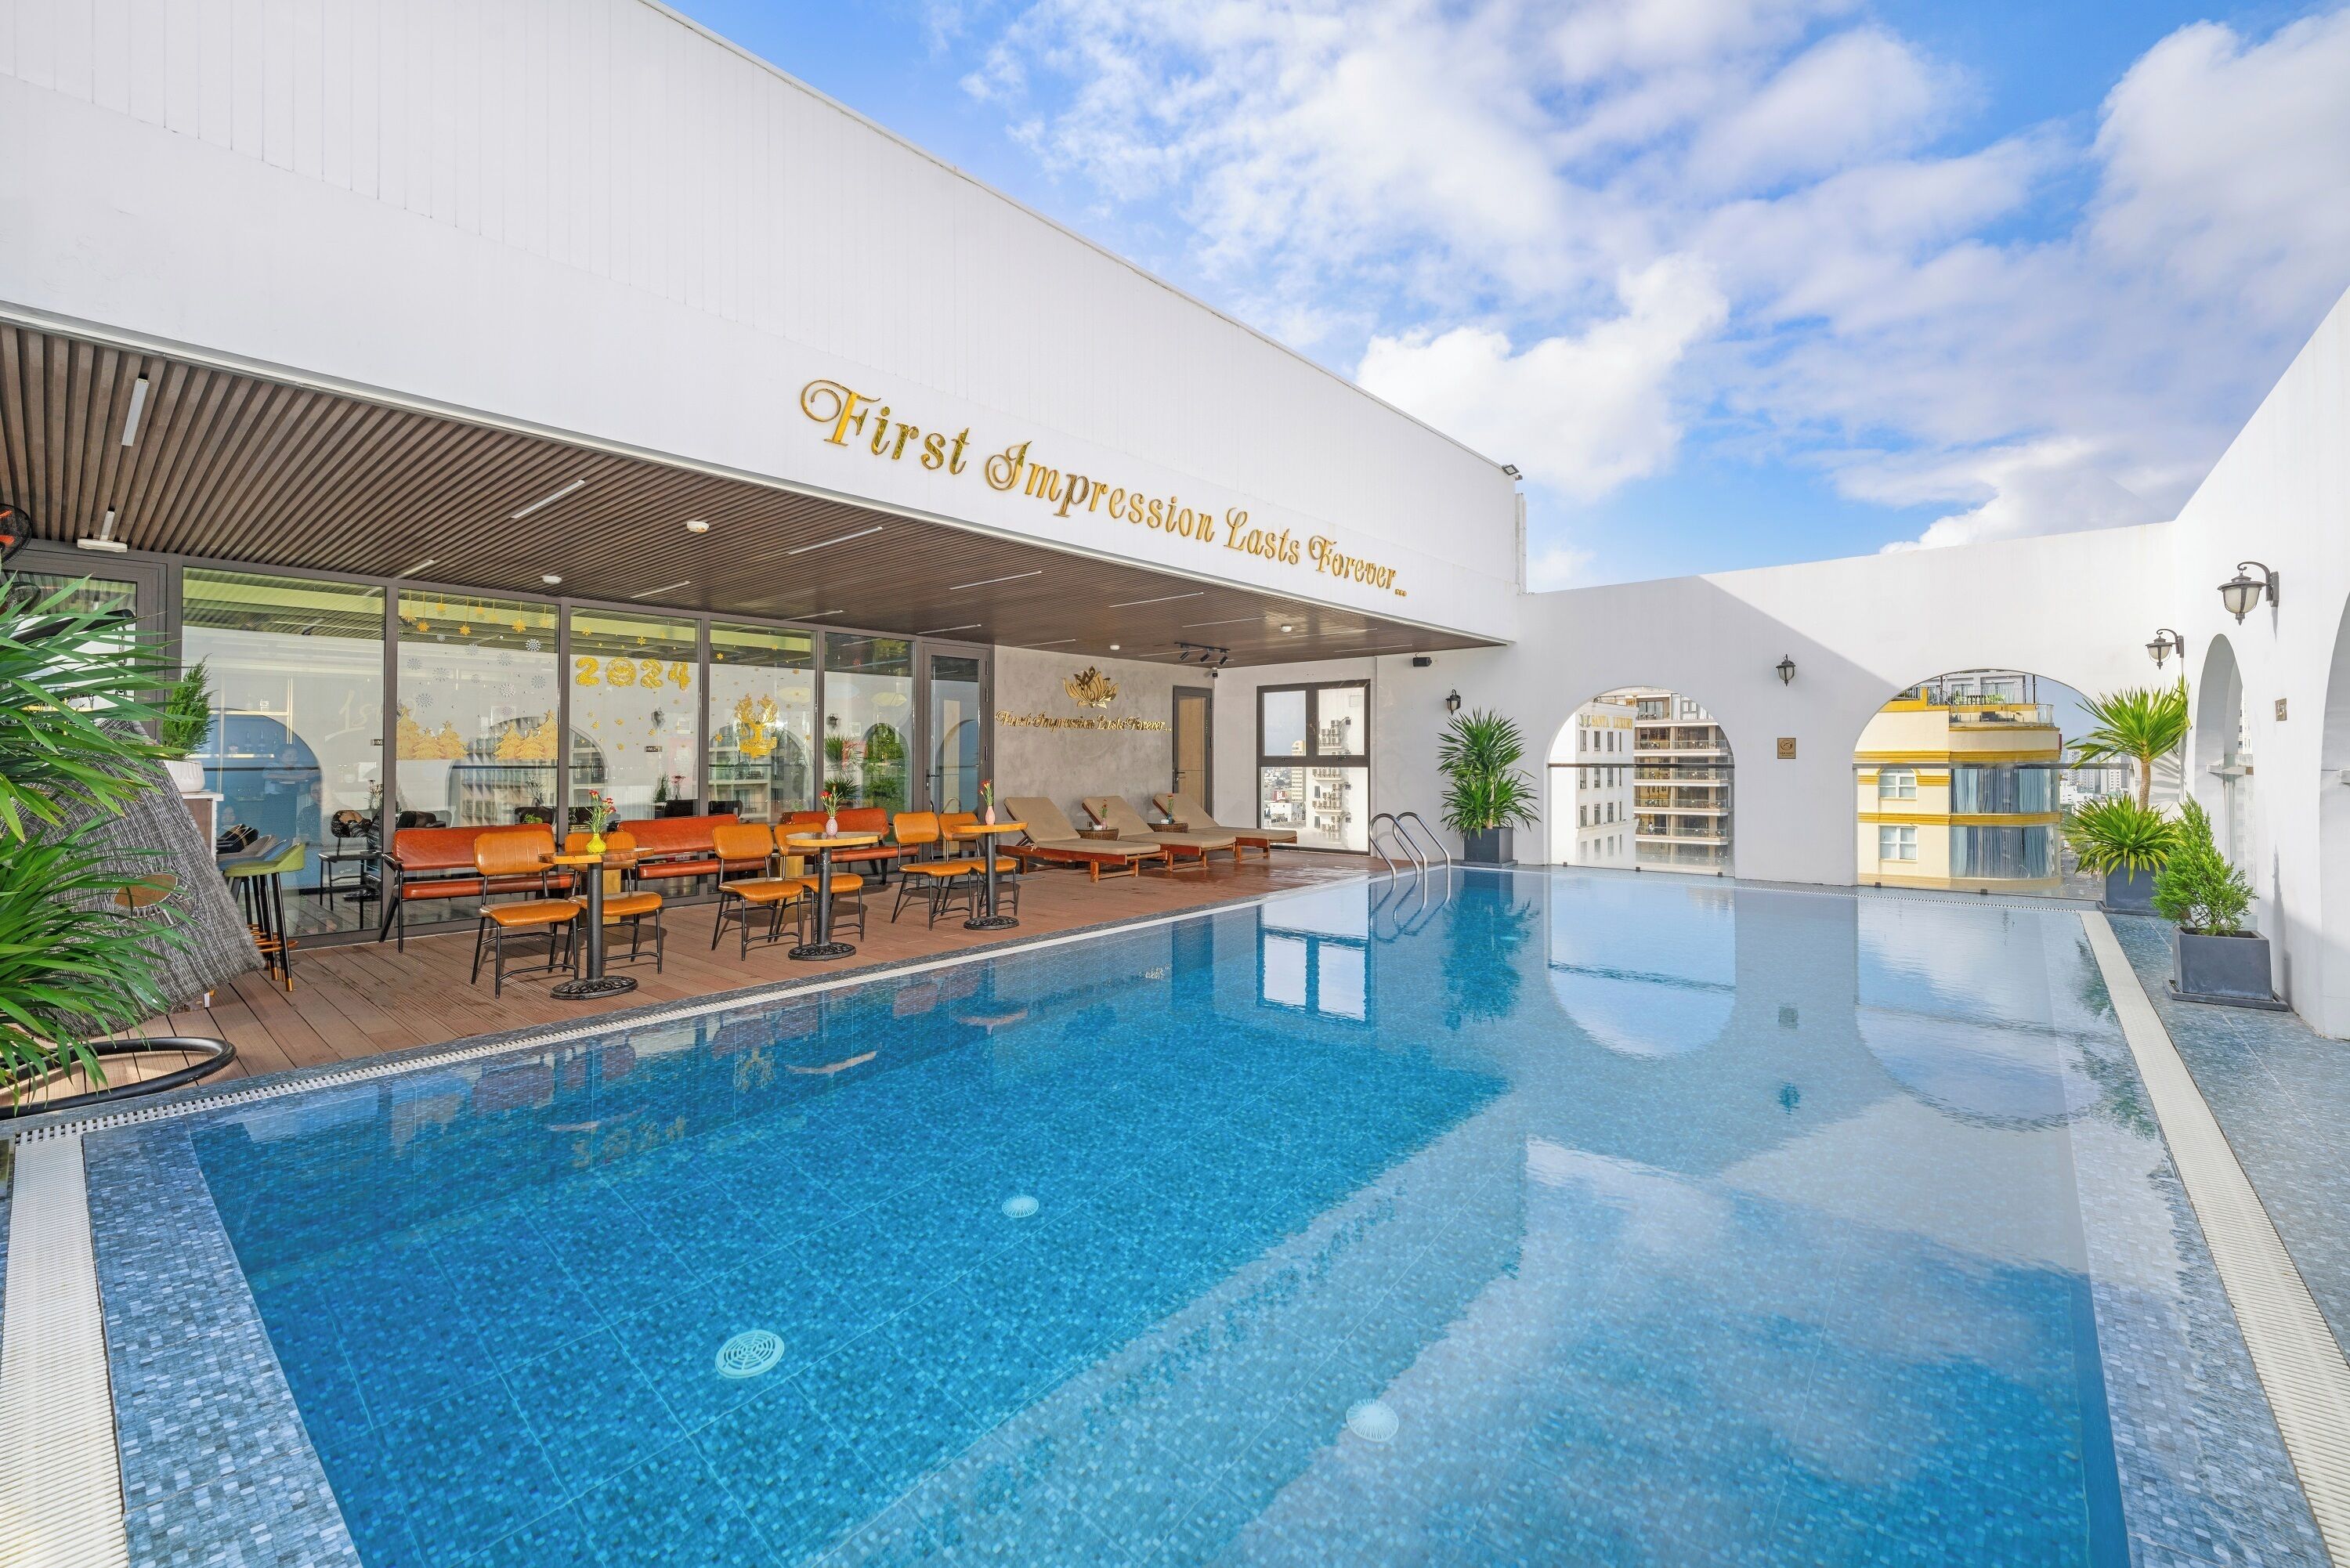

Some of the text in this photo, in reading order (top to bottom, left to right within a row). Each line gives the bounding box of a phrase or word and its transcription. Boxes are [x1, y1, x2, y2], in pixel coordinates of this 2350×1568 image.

[800, 379, 970, 475] First
[985, 440, 1216, 544] Impression
[1224, 507, 1300, 565] Lasts
[575, 656, 691, 690] 2024
[996, 710, 1031, 727] First
[1033, 711, 1094, 732] Impression
[1097, 714, 1125, 730] Lasts
[1591, 714, 1632, 729] SANTA LUXURY
